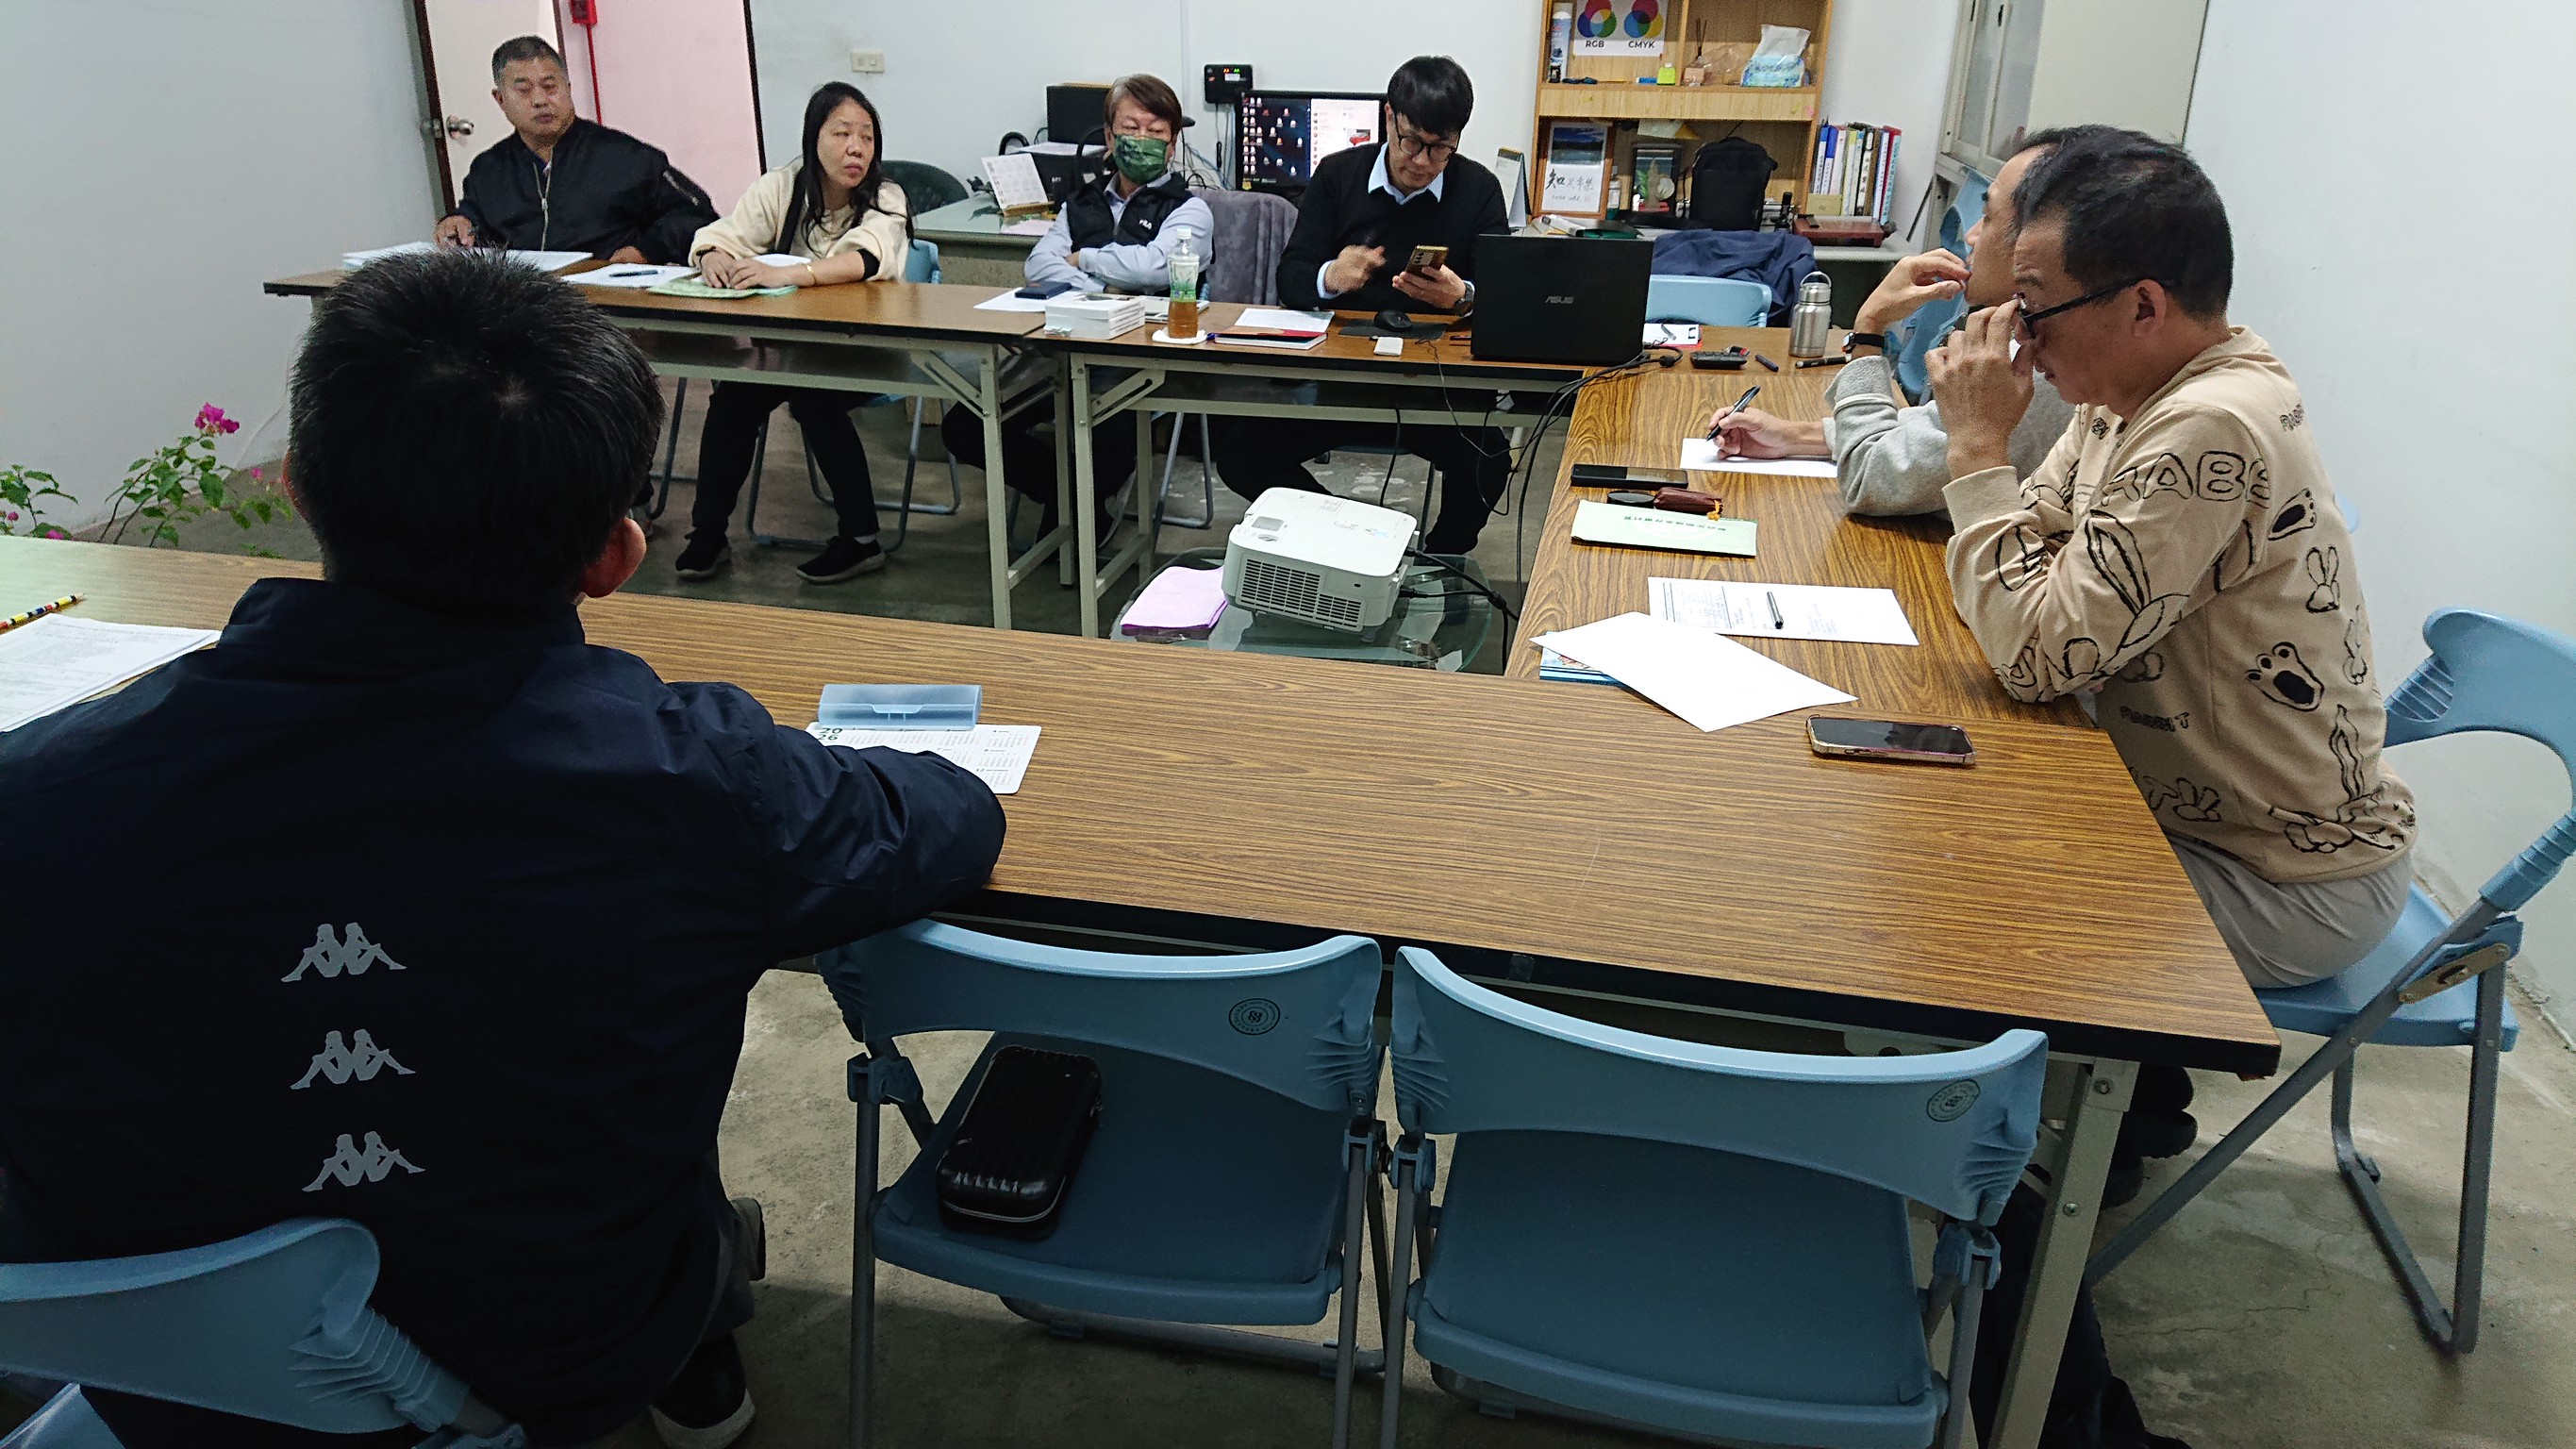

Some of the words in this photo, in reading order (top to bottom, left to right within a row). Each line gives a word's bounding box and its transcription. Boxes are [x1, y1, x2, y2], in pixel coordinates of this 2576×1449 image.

[1585, 40, 1604, 48] RGB
[1628, 41, 1656, 49] CMYK
[1545, 295, 1574, 304] ASUS
